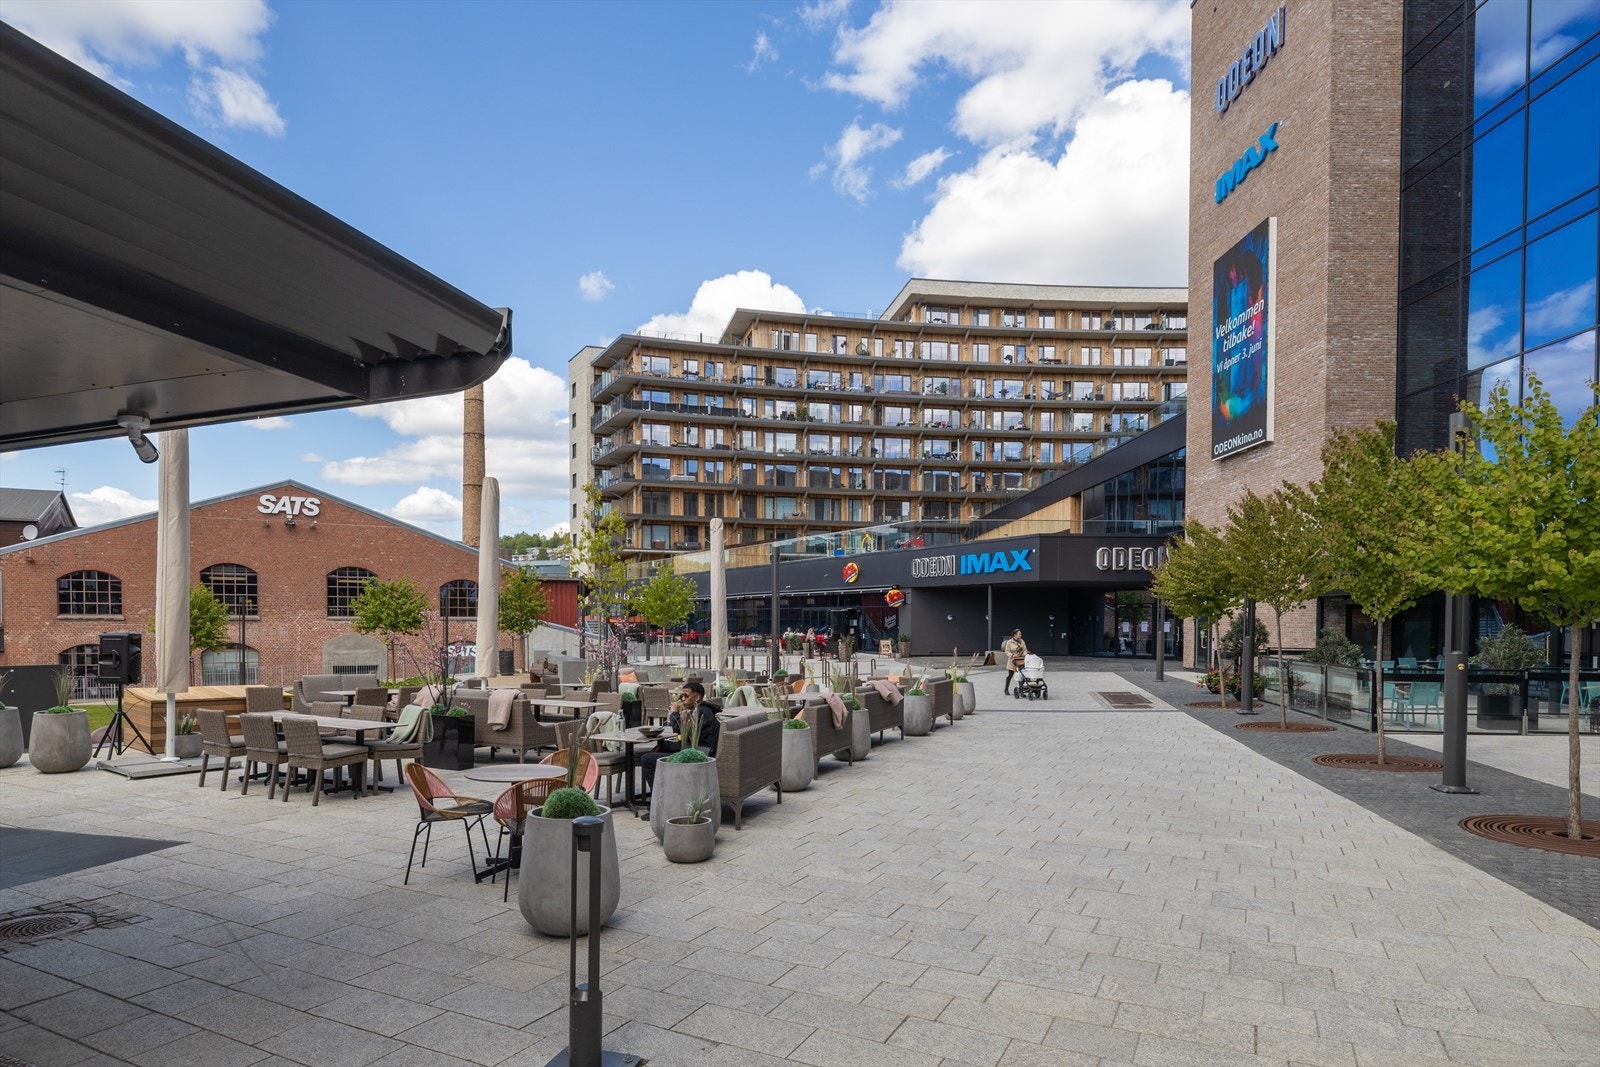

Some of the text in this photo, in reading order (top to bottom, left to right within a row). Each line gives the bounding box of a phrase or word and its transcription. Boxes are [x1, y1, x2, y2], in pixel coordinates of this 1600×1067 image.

[1215, 6, 1286, 113] ODEON
[1215, 121, 1279, 204] IMAX
[1215, 298, 1265, 340] Velkommen
[1223, 319, 1256, 353] tilbake!
[1216, 361, 1224, 374] Vi
[1241, 347, 1248, 360] 3.
[1247, 337, 1263, 358] juni
[1213, 428, 1263, 455] ODEONkino.no
[257, 494, 321, 517] SATS
[911, 548, 1033, 578] ODEON IMAX
